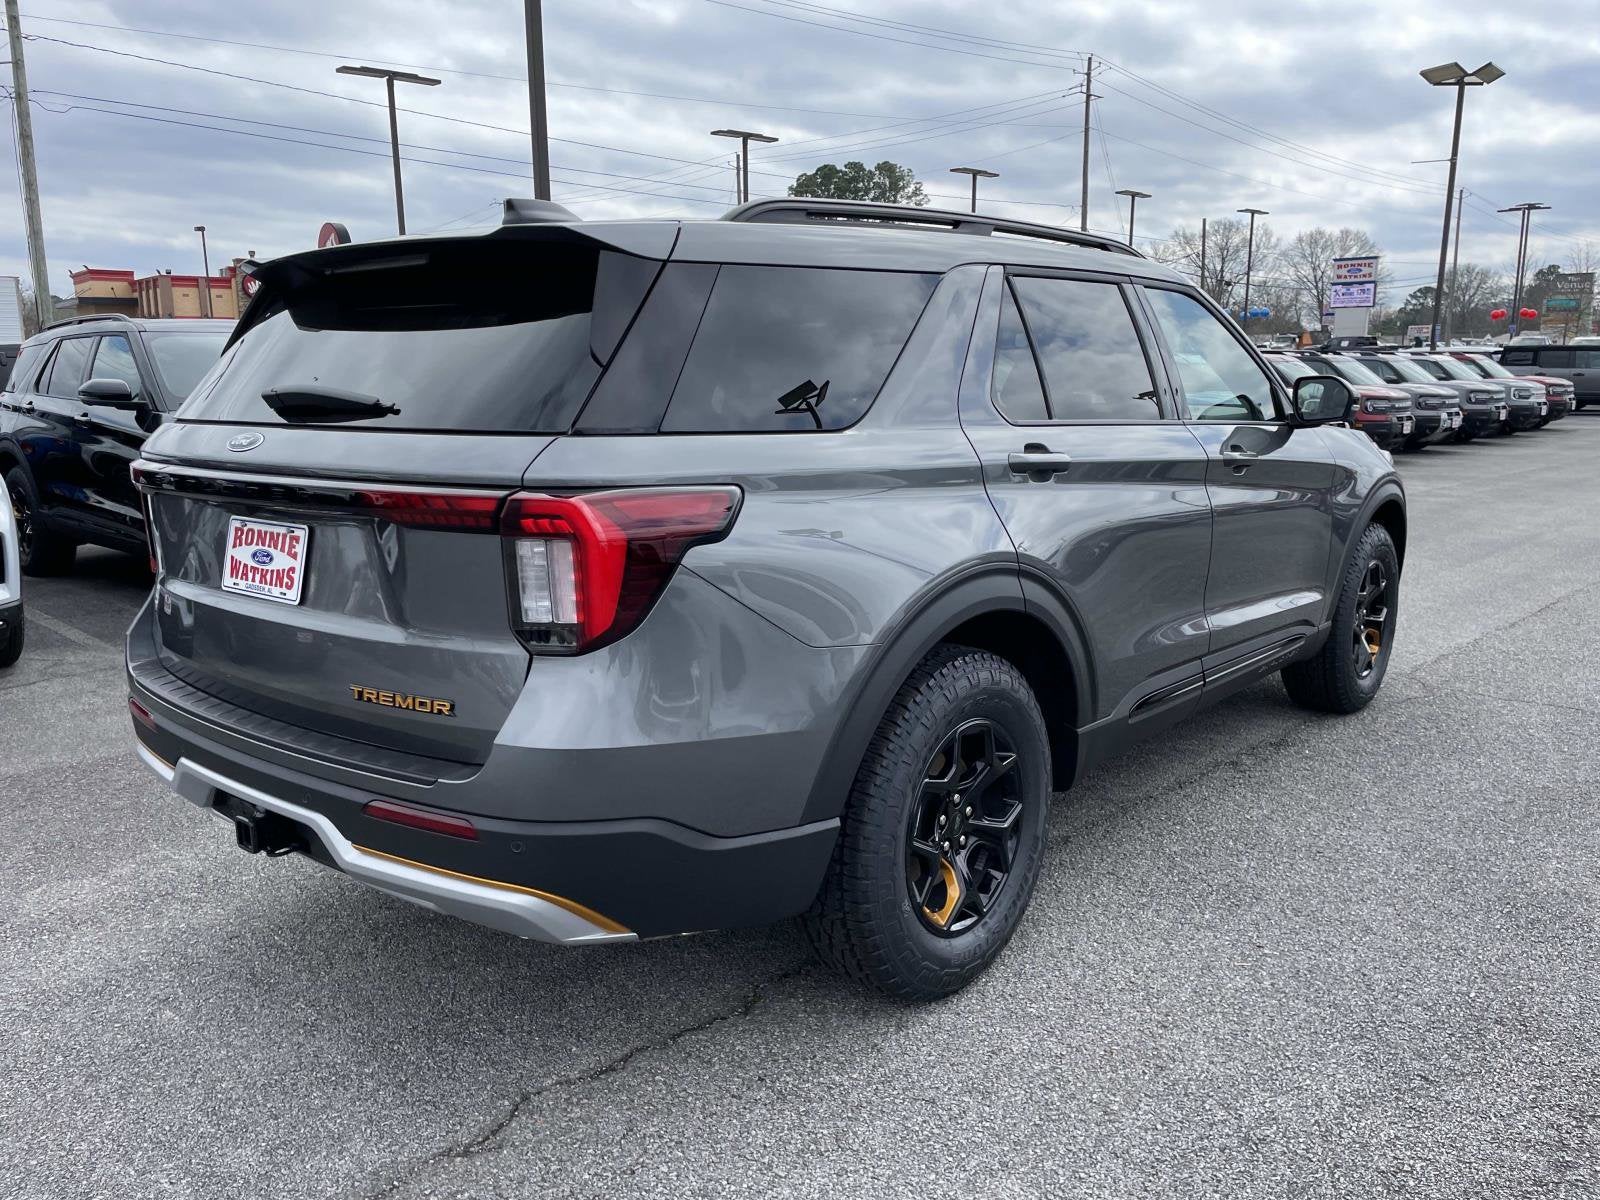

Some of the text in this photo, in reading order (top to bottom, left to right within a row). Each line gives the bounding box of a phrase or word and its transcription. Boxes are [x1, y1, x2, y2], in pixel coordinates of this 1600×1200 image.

[1336, 272, 1373, 280] WATKINS
[1337, 262, 1374, 270] RONNIE
[232, 526, 301, 561] RONNIE
[254, 551, 272, 563] Ford
[230, 554, 296, 591] WATKINS
[349, 683, 454, 717] TREMOR
